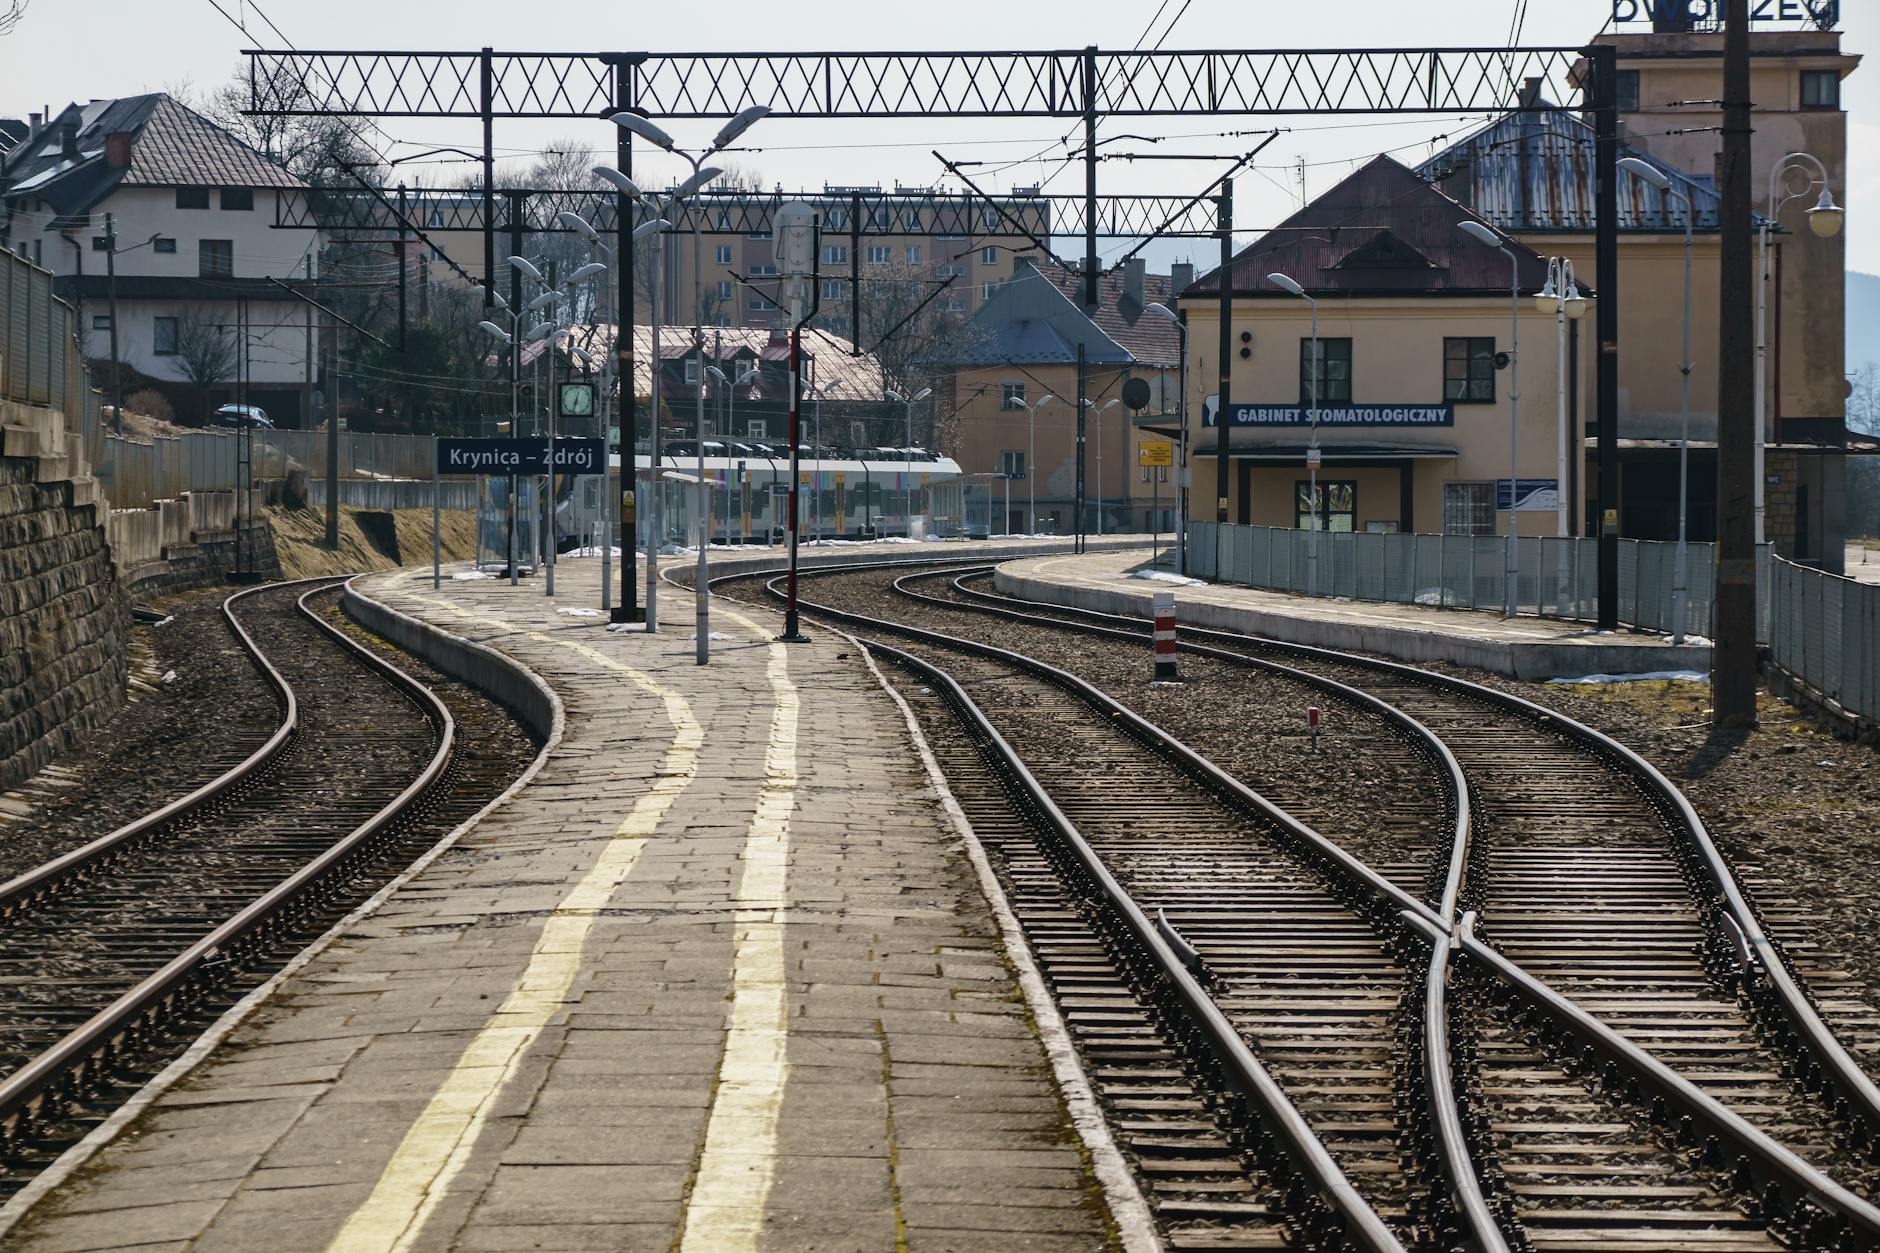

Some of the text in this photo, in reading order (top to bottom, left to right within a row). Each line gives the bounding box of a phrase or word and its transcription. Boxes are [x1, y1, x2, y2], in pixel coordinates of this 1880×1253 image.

[1237, 408, 1447, 422] GABINET STOMATOLOGICZNY
[450, 449, 520, 469] Krynica
[543, 448, 593, 469] Zdrój
